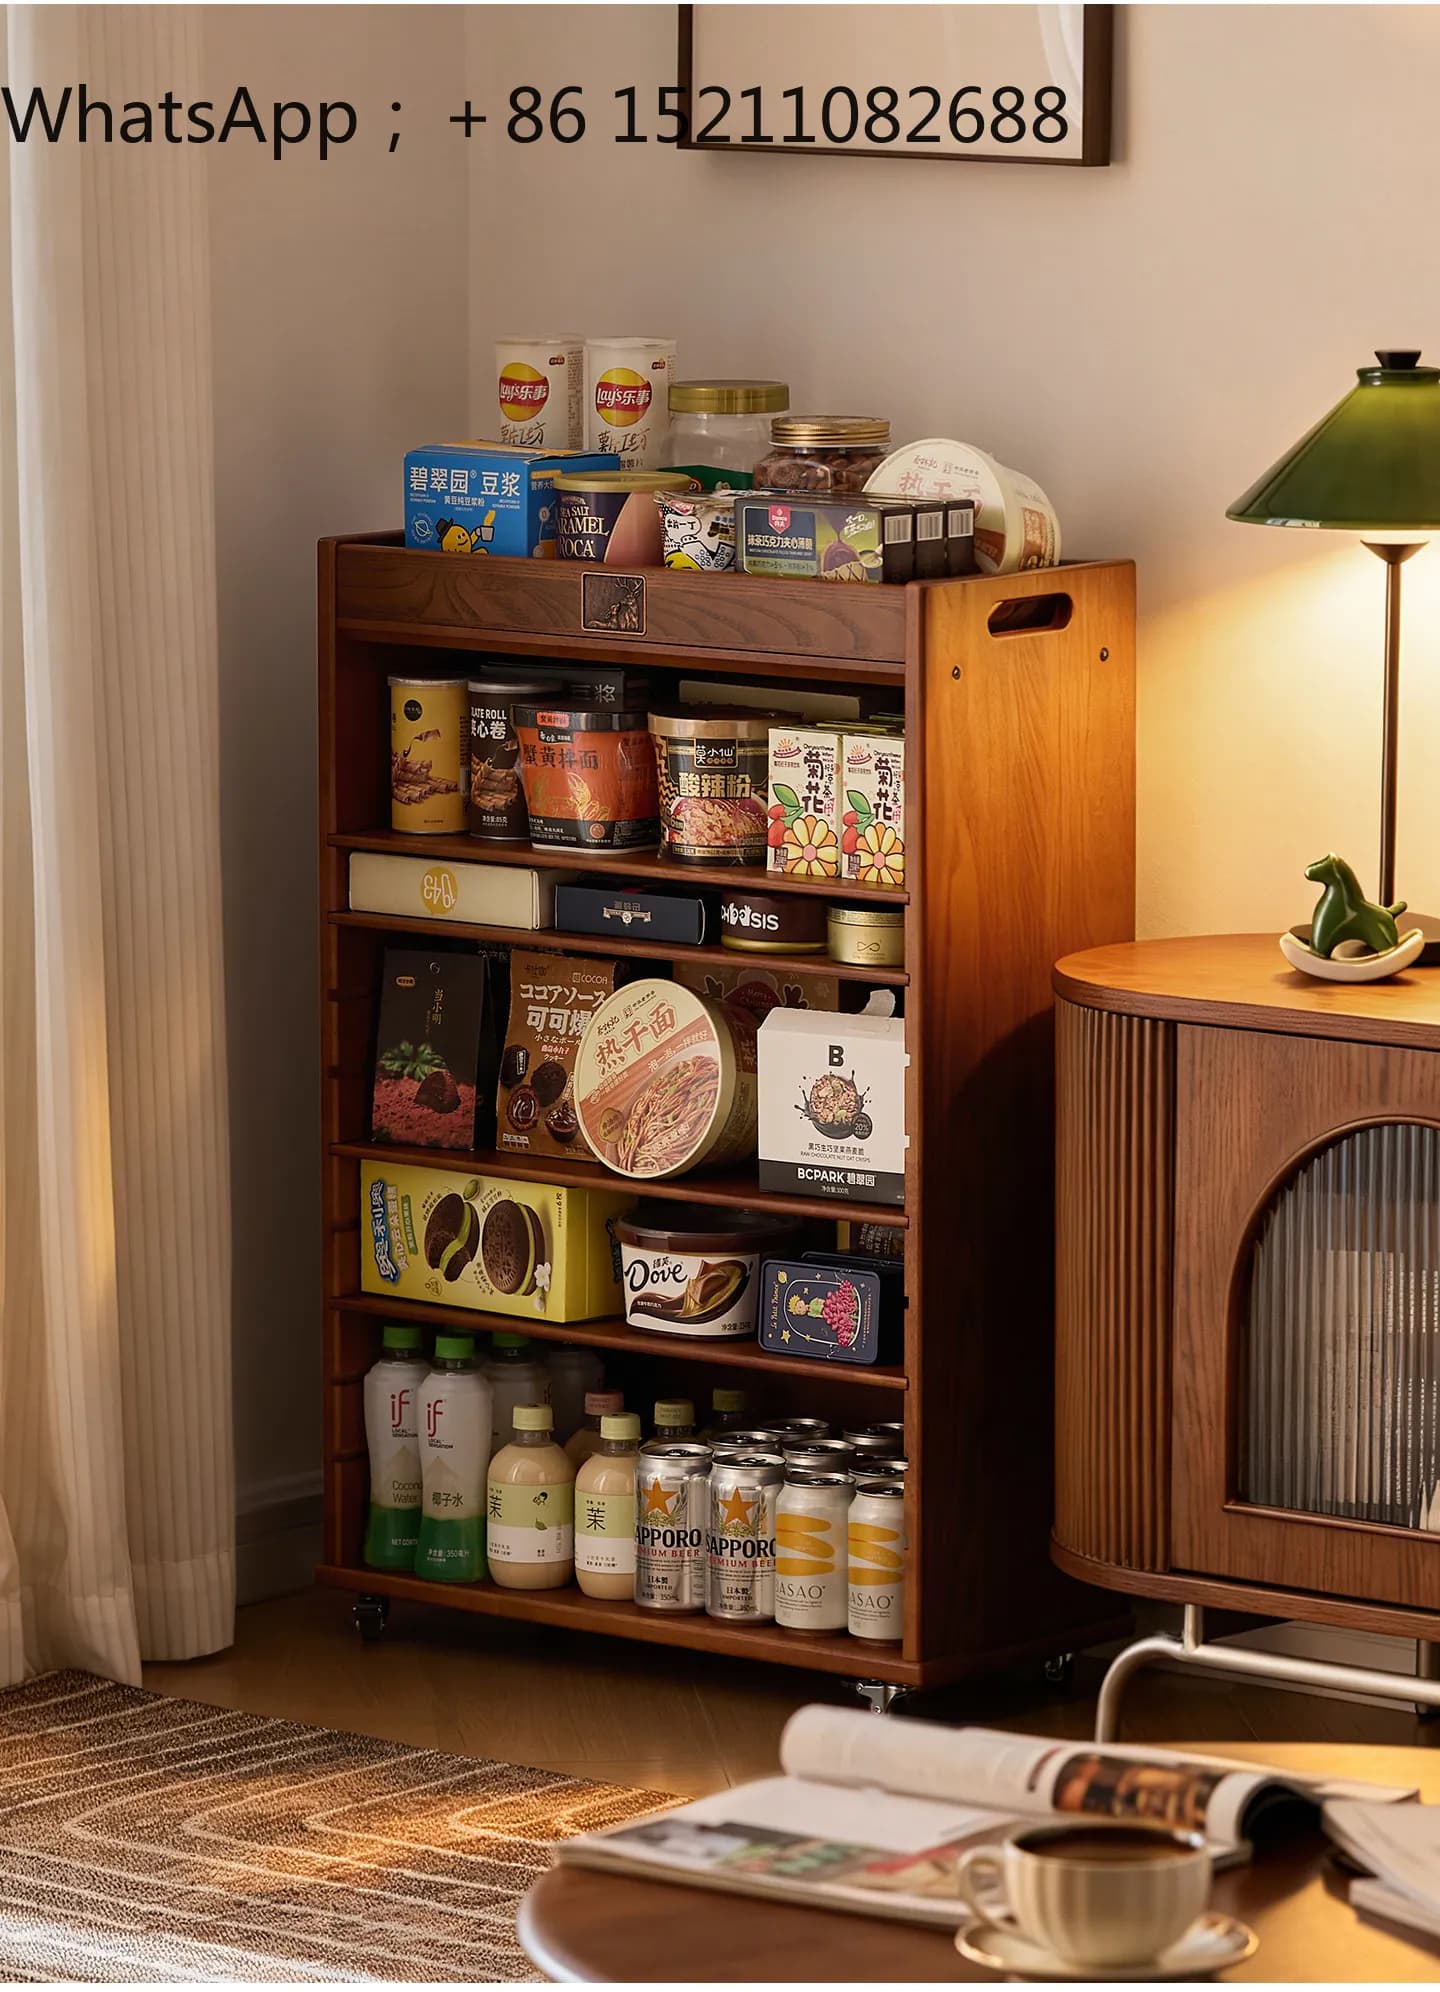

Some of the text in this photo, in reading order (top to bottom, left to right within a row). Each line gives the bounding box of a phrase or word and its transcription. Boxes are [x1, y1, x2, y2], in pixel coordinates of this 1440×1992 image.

[480, 471, 520, 497] 豆浆
[571, 506, 590, 516] SALT
[560, 536, 596, 558] ROCA
[485, 709, 507, 720] ROLL
[523, 744, 600, 769] 蟹黄拌面
[678, 771, 752, 798] 酸辣粉
[801, 749, 825, 815] 菊花
[873, 757, 893, 822] 菊花
[581, 974, 608, 985] COCOA
[519, 983, 607, 1008] ココアソース
[595, 1001, 678, 1078] 热干面
[829, 1044, 844, 1067] B
[797, 1168, 845, 1184] BCPARK
[624, 1259, 688, 1292] Dove
[390, 1389, 411, 1428] if
[427, 1400, 444, 1437] if
[392, 1480, 423, 1491] Coconu
[432, 1491, 464, 1508] 椰子水
[488, 1494, 503, 1519] 茉
[586, 1507, 606, 1531] 茉
[636, 1525, 702, 1548] APPORO
[671, 1550, 700, 1558] BEER
